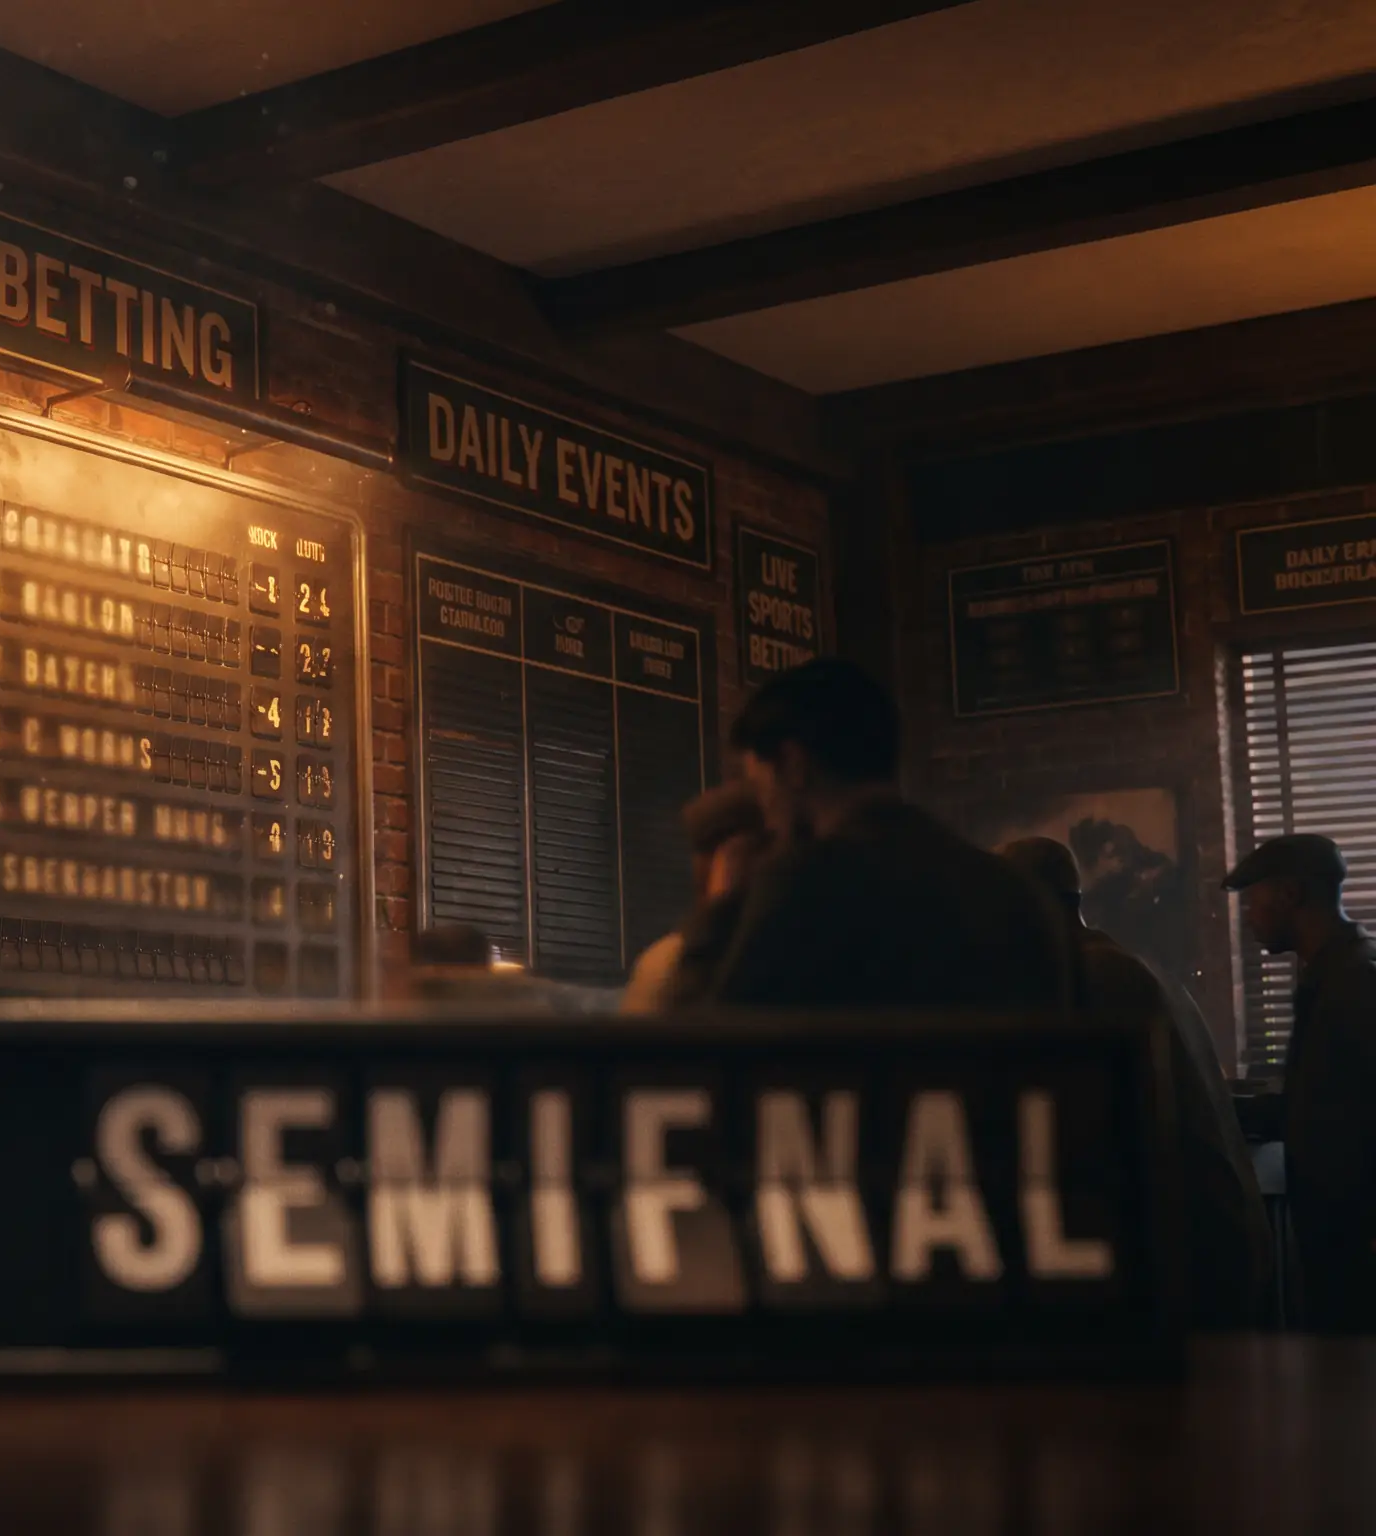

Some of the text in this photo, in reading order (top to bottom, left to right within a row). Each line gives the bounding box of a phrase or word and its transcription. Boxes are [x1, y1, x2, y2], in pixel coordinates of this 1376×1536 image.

[428, 391, 694, 541] DAILY EVENTS
[760, 551, 799, 594] LIVE
[747, 590, 814, 641] SPORTS
[749, 633, 817, 672] BETTIN
[91, 1083, 1114, 1292] SEMIFNAL
